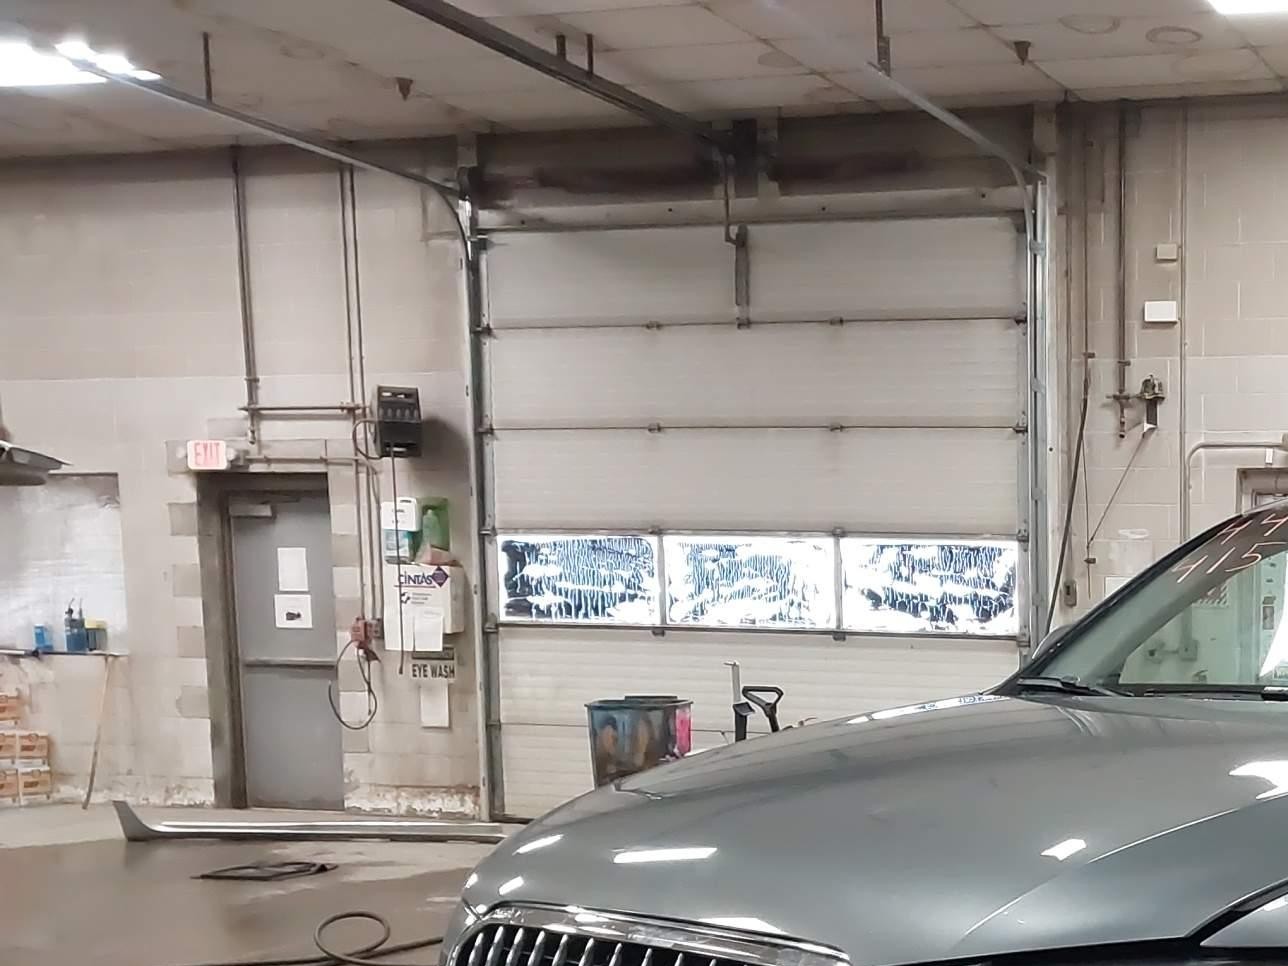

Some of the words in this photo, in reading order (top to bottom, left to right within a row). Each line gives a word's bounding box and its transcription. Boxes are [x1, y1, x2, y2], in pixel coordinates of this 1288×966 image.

[195, 442, 220, 465] EXIT
[412, 663, 428, 678] EYE
[430, 664, 455, 679] WASH
